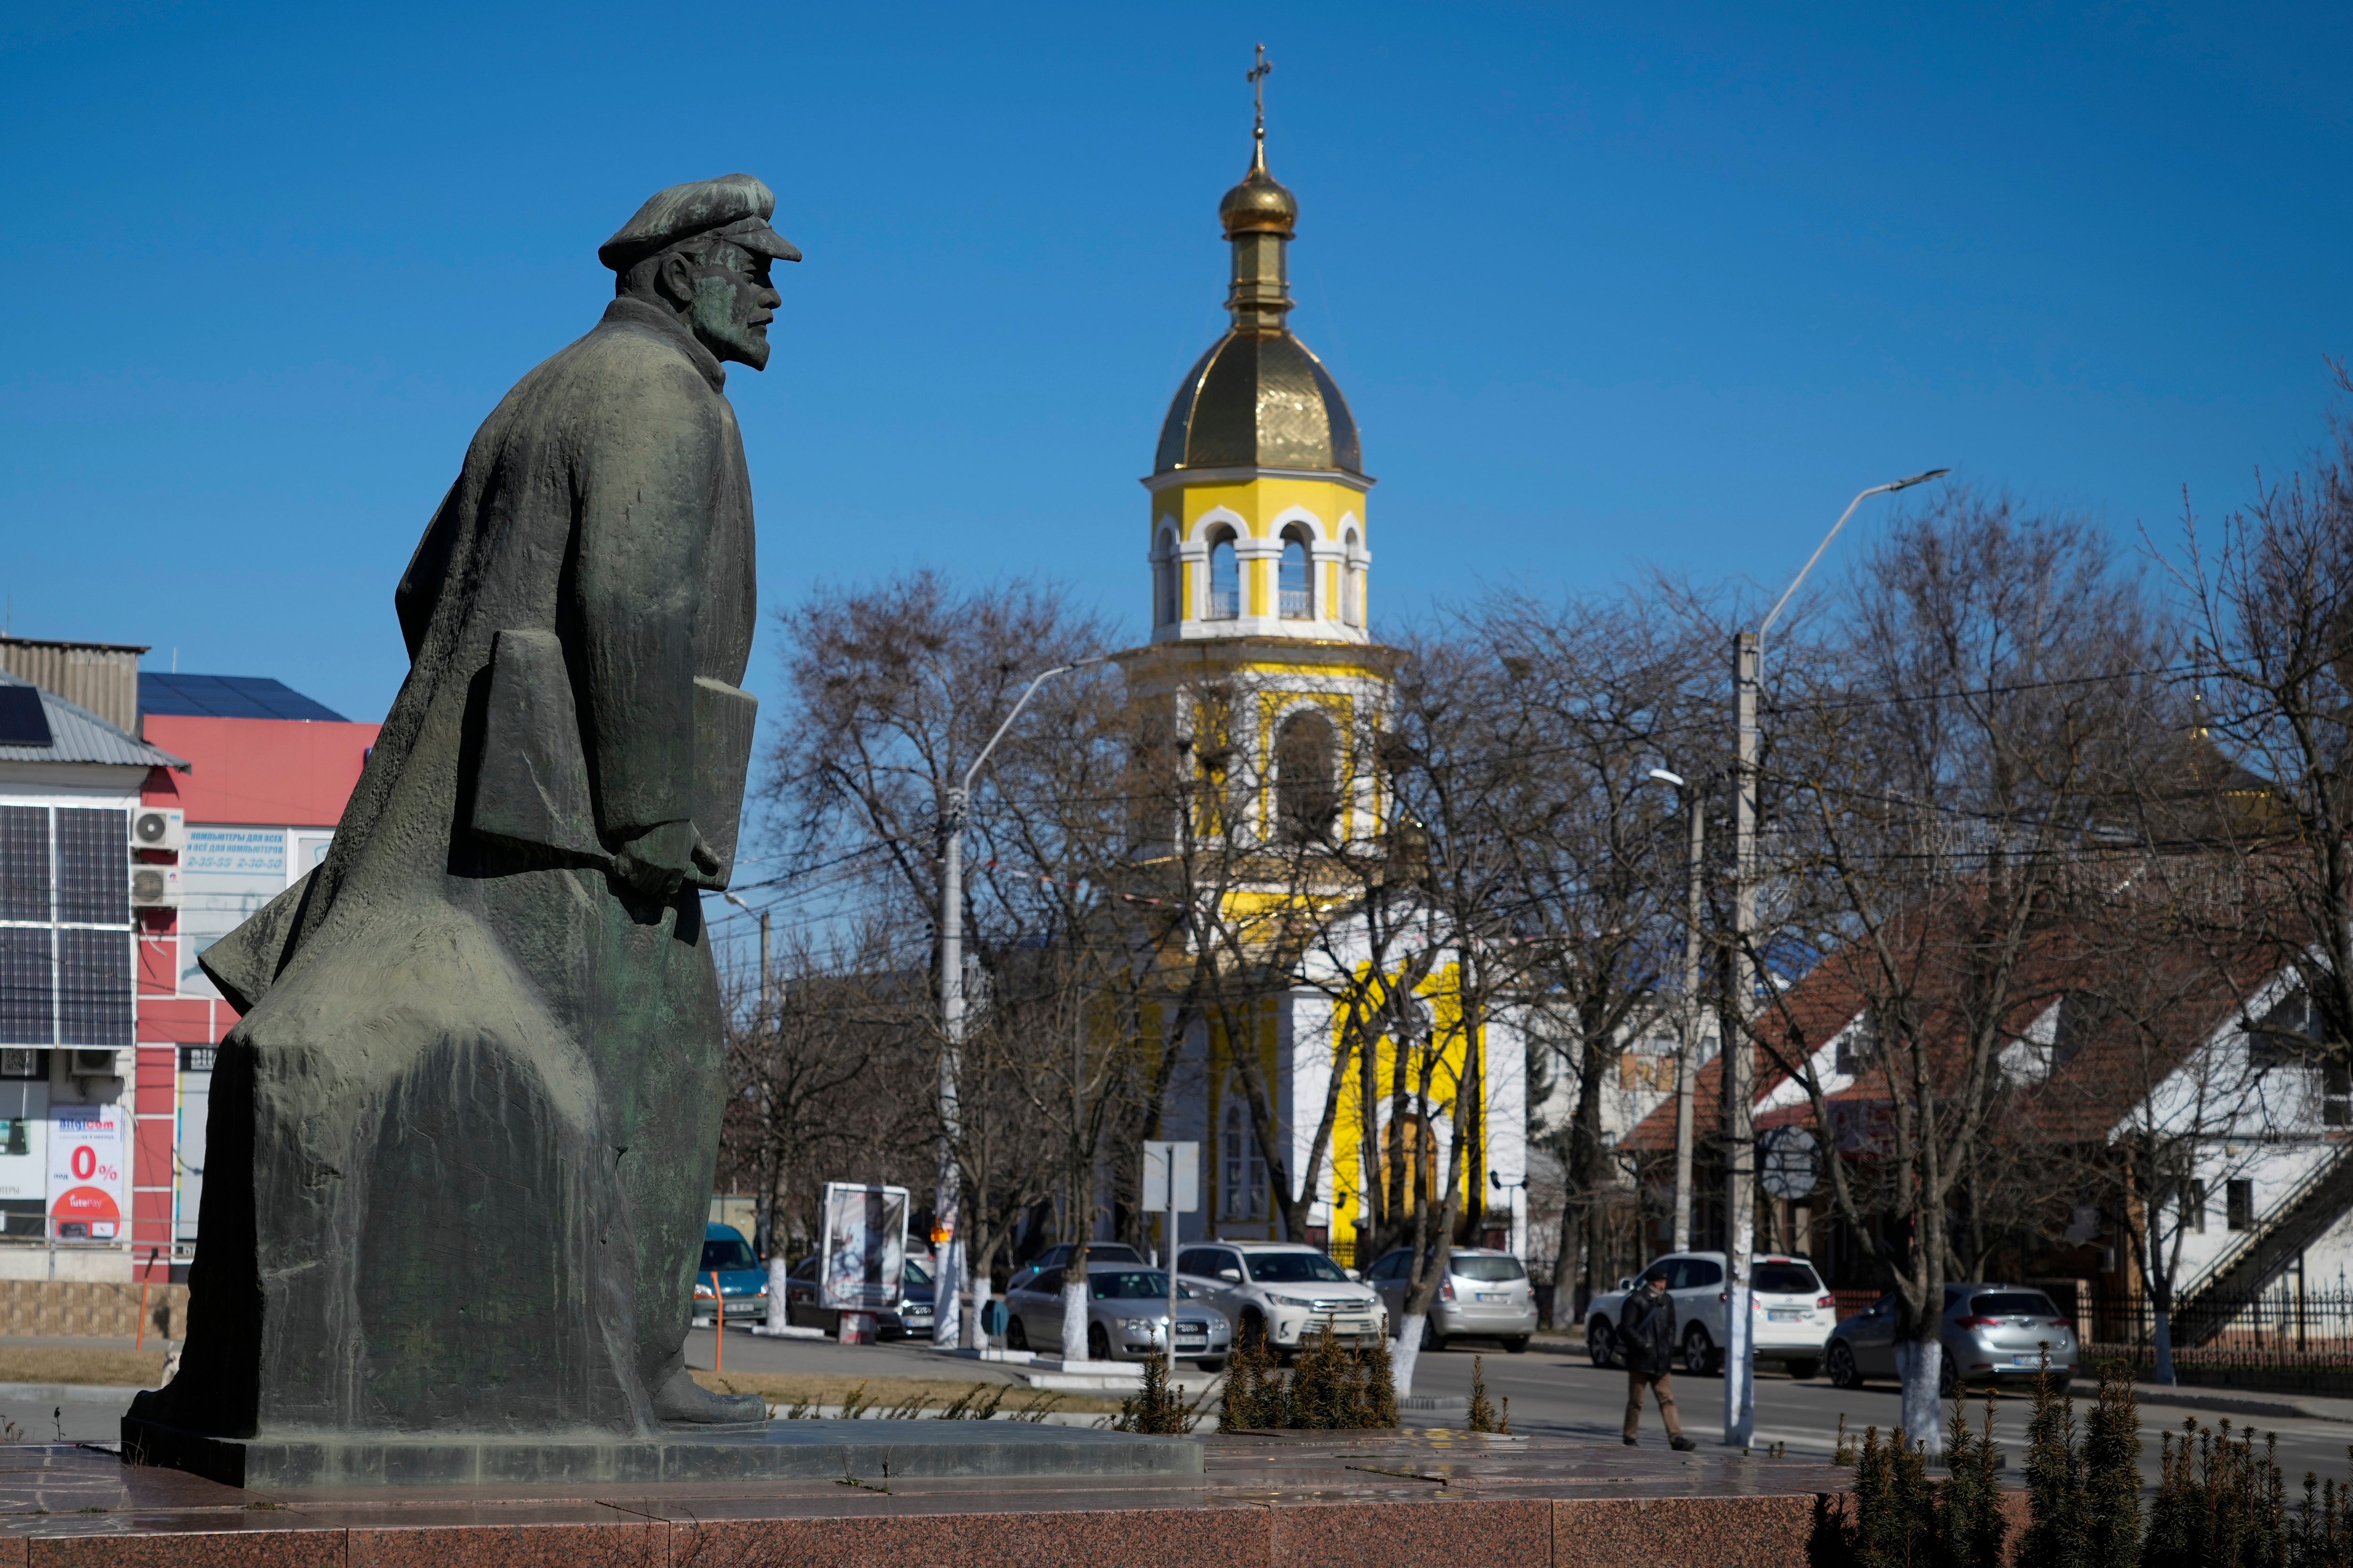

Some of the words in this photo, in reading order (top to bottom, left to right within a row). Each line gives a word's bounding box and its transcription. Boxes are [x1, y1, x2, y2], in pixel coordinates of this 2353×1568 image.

[191, 832, 245, 841] КОМПЬЮТЕРЫ
[247, 833, 263, 842] ДЛЯ
[264, 834, 282, 842] ВСЕХ
[187, 843, 192, 851] И
[208, 844, 225, 853] ДЛЯ
[226, 845, 282, 854] КОМПЬЮТЕРОВ
